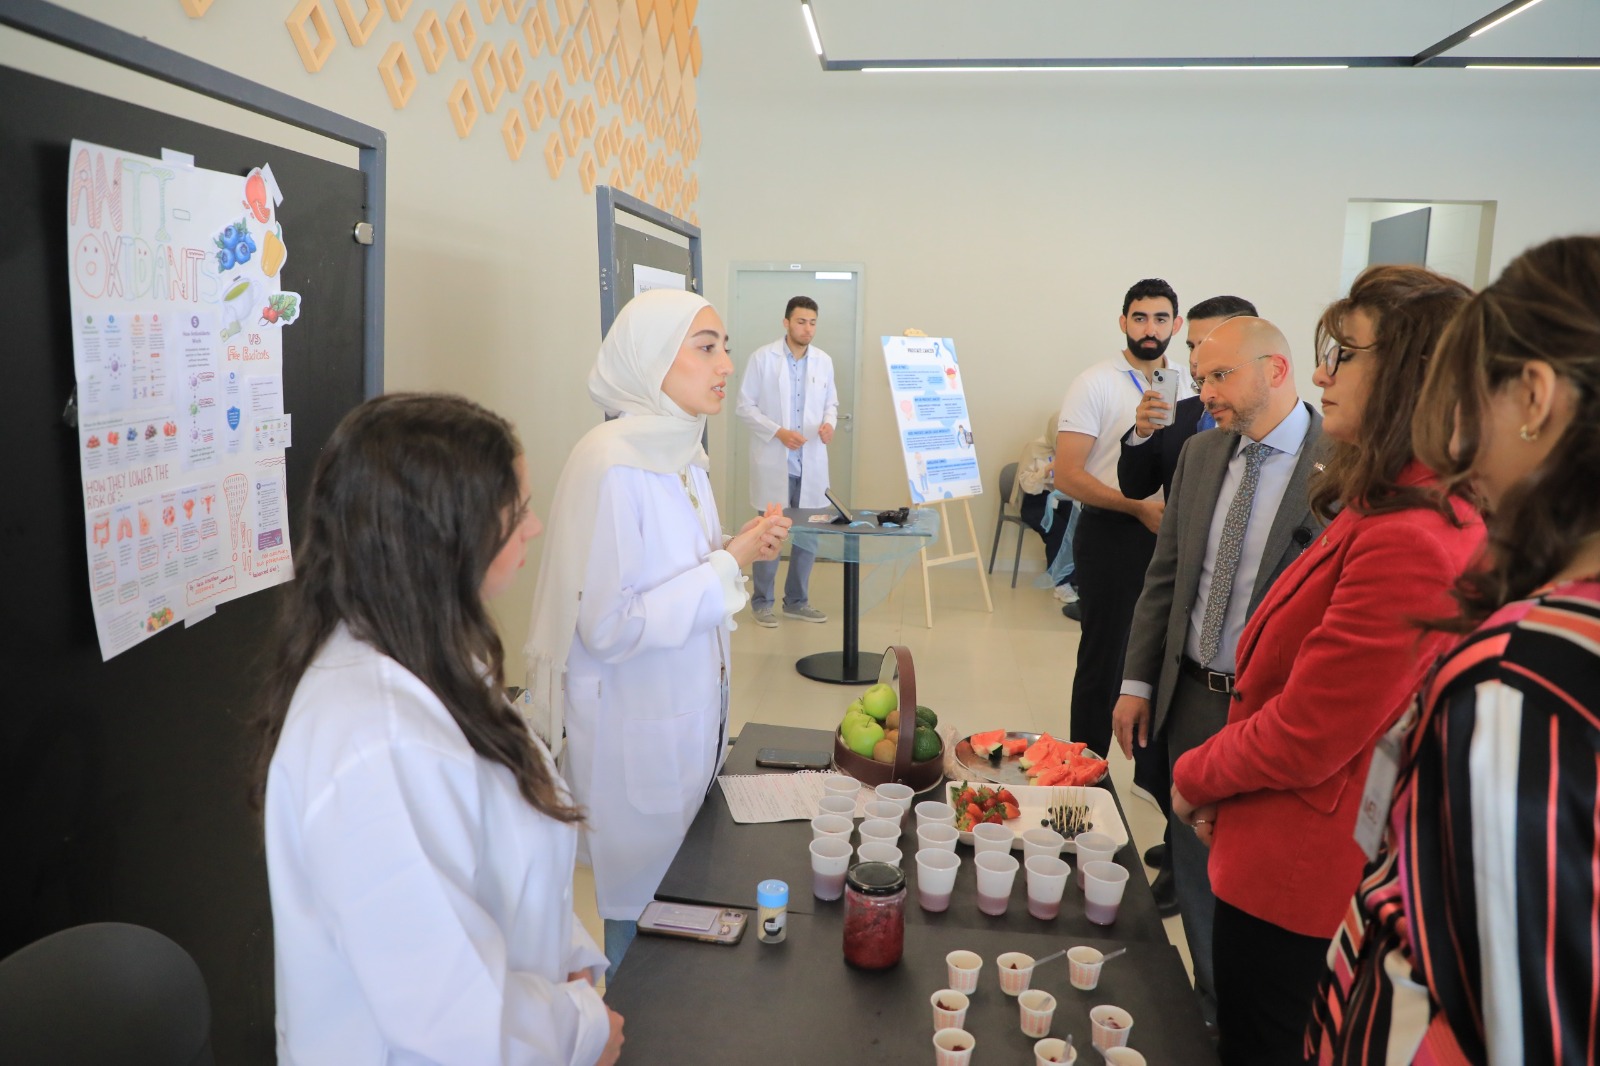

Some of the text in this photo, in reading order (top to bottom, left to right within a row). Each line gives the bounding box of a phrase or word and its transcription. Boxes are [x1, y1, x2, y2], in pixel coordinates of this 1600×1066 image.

[74, 231, 221, 304] OXIDANTS
[86, 463, 169, 494] HOW THEY LOWER THE
[86, 494, 105, 509] RISK
